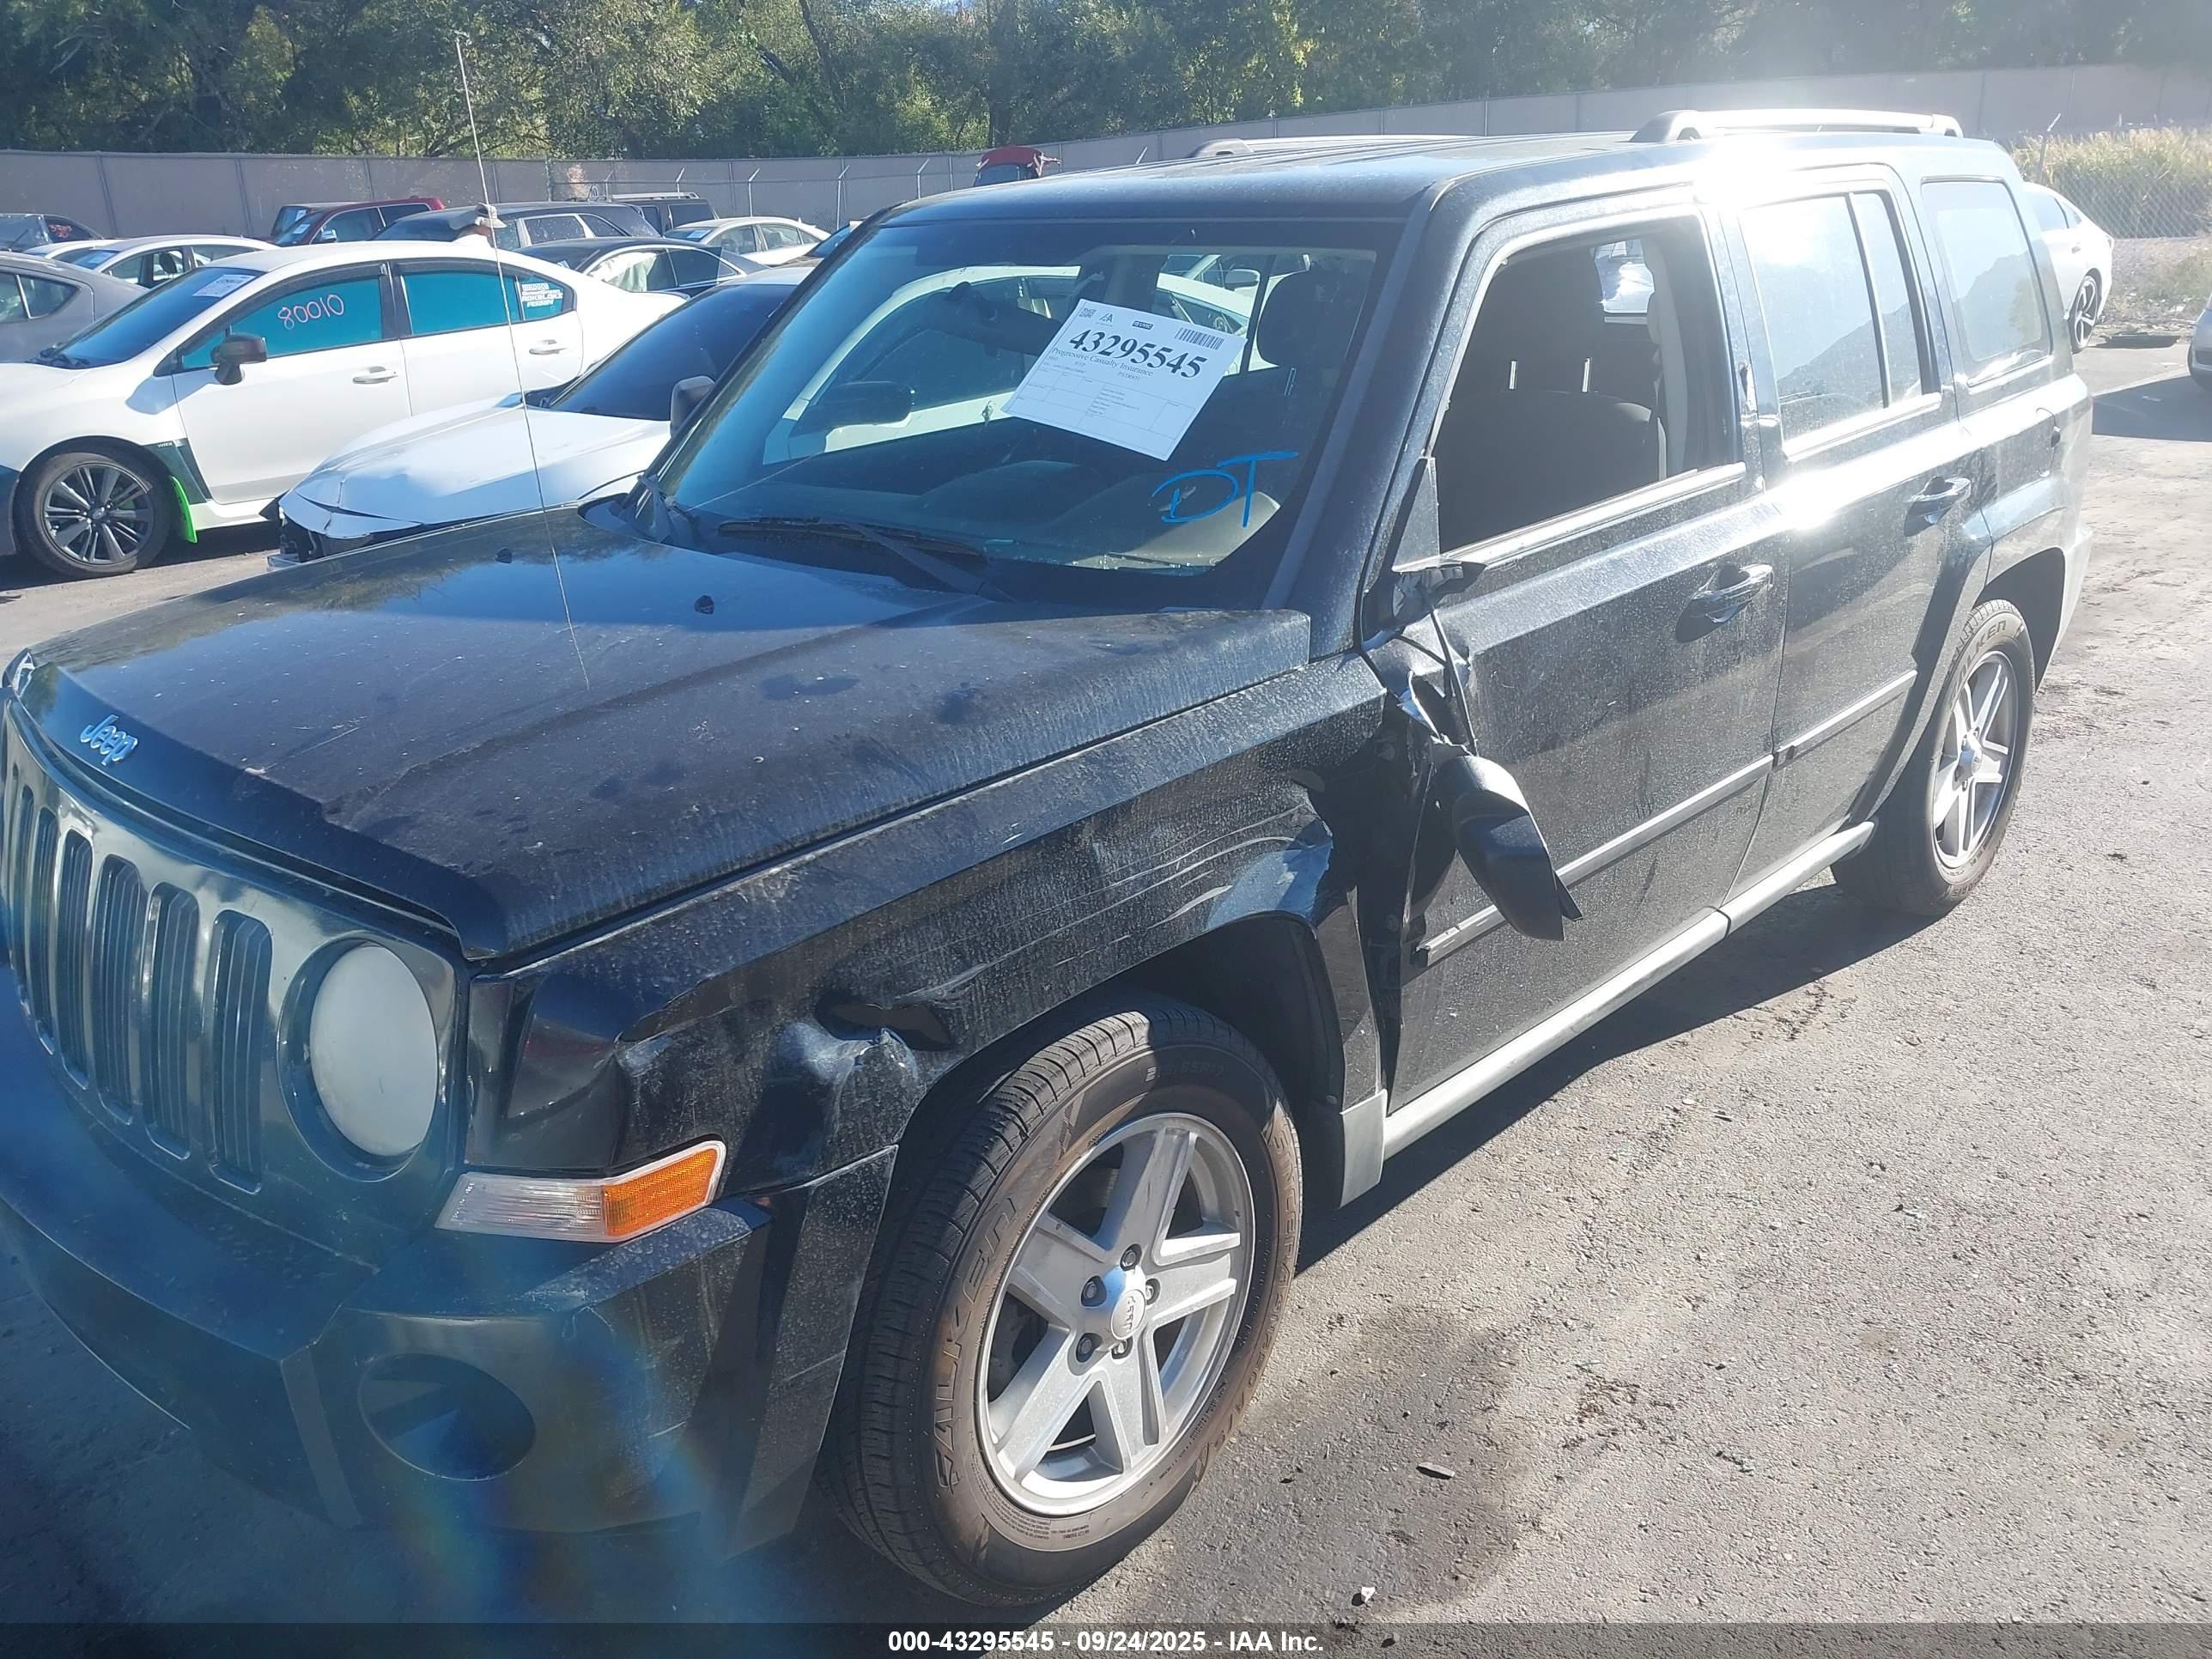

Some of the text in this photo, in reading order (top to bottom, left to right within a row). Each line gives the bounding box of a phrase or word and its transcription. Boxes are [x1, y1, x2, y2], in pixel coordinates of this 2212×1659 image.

[277, 294, 344, 330] 80010
[1052, 348, 1090, 362] Progressive
[1090, 355, 1117, 368] Casualty
[1120, 363, 1153, 377] Insurance
[1069, 329, 1208, 379] 43295545
[80, 714, 138, 766] Jeep
